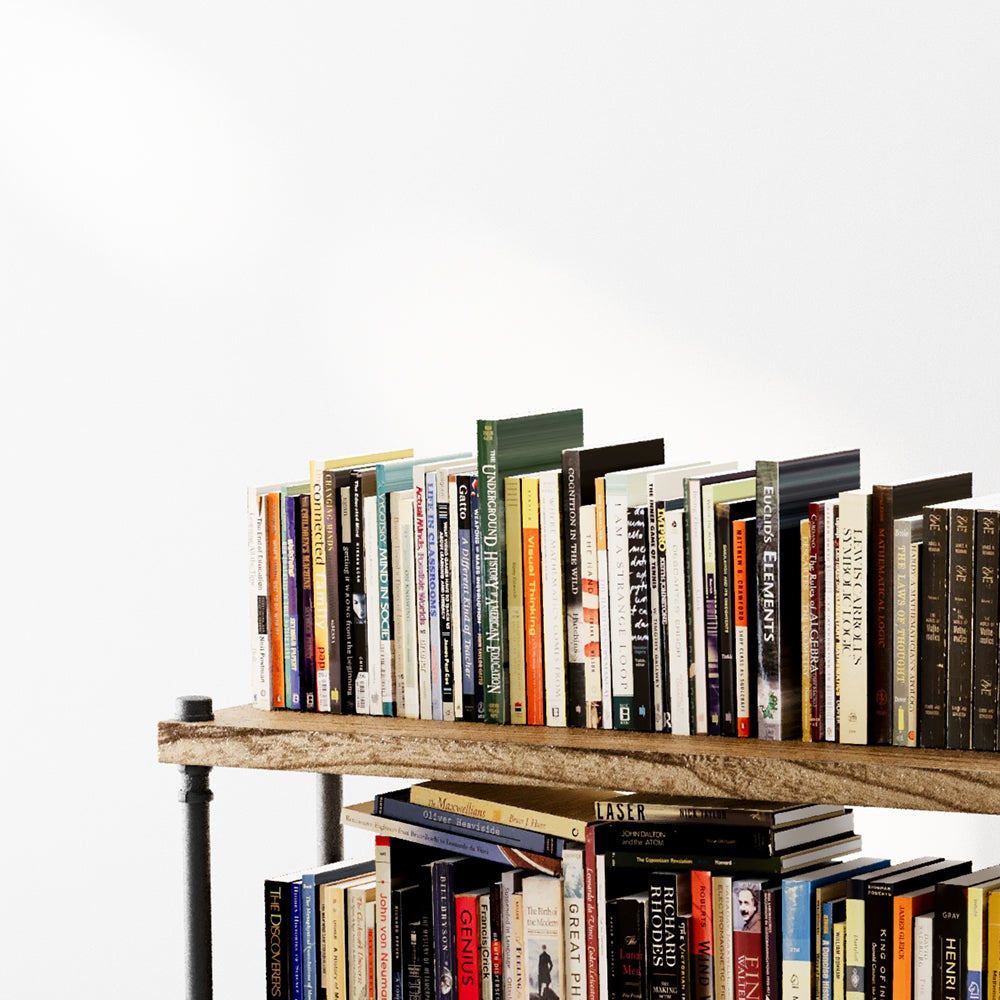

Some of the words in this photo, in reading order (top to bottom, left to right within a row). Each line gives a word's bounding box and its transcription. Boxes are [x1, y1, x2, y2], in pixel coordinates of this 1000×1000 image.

[314, 484, 325, 565] connected
[379, 494, 387, 544] VYGOTSKY
[459, 485, 468, 519] Gatto
[764, 486, 775, 543] EUCLID'S
[658, 508, 666, 551] IMPRO
[342, 546, 351, 573] getting
[379, 548, 388, 582] MIND
[527, 536, 536, 576] Visual
[842, 529, 852, 607] SYMBOLIC
[316, 572, 328, 629] family
[380, 586, 388, 599] IN
[529, 581, 537, 636] Thinking
[764, 550, 777, 641] ELEMENTS
[381, 603, 389, 639] SOCIE
[842, 611, 852, 655] LOGIC
[438, 797, 486, 818] Maxwellians
[597, 803, 645, 821] LASER
[380, 894, 389, 924] John
[651, 886, 663, 966] RHODES
[663, 887, 675, 967] RICHARD
[461, 910, 474, 985] GENIUS
[569, 904, 580, 962] GREAT
[698, 941, 711, 986] WIND
[880, 967, 886, 981] OF
[945, 938, 955, 989] HENRI
